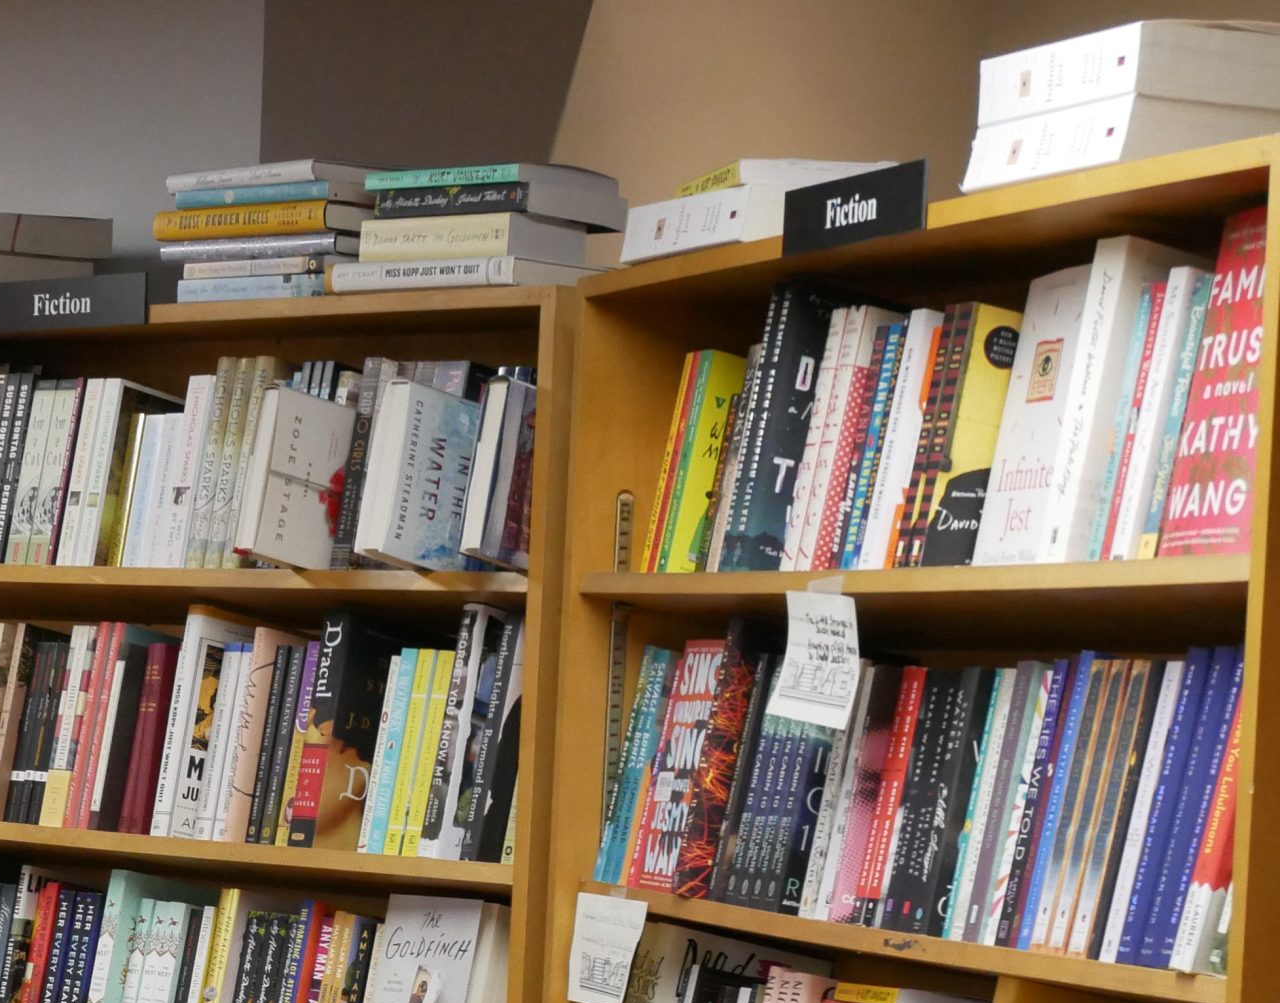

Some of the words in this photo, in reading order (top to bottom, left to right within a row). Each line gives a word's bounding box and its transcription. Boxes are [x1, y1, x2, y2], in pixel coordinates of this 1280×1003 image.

[428, 169, 449, 183] KURT
[452, 167, 498, 181] VONNEGUT
[825, 196, 877, 229] Fiction
[385, 268, 401, 278] MISS
[402, 267, 420, 277] KOPP
[420, 266, 438, 276] JUST
[440, 265, 461, 274] WON'T
[463, 263, 481, 274] QUIT
[33, 293, 91, 317] Fiction
[1200, 326, 1263, 371] TRUS
[288, 416, 302, 466] ZOJE
[408, 401, 424, 458] CATHERINE
[1178, 416, 1260, 457] KATHY
[421, 438, 447, 522] WATER
[460, 456, 471, 472] IN
[998, 456, 1052, 493] Infinite
[274, 477, 291, 542] STAGE
[394, 463, 416, 540] STEADMAN
[451, 484, 467, 521] THE
[1169, 477, 1248, 519] WANG
[1002, 500, 1031, 536] Jest
[316, 621, 342, 699] Dracul
[452, 632, 469, 695] FORGET
[494, 625, 513, 682] Northern
[444, 696, 458, 716] YOU
[486, 684, 500, 718] Lights
[1046, 673, 1062, 710] THE
[439, 720, 451, 760] KNOW
[477, 729, 494, 779] Raymond
[1036, 717, 1052, 760] LIES
[433, 766, 442, 786] ME
[1028, 769, 1042, 801] WE
[468, 783, 484, 823] Strom
[1015, 811, 1033, 861] TOLD
[58, 902, 68, 929] HER
[48, 932, 62, 971] EVERY
[322, 926, 333, 953] ANY
[313, 955, 325, 980] MAN
